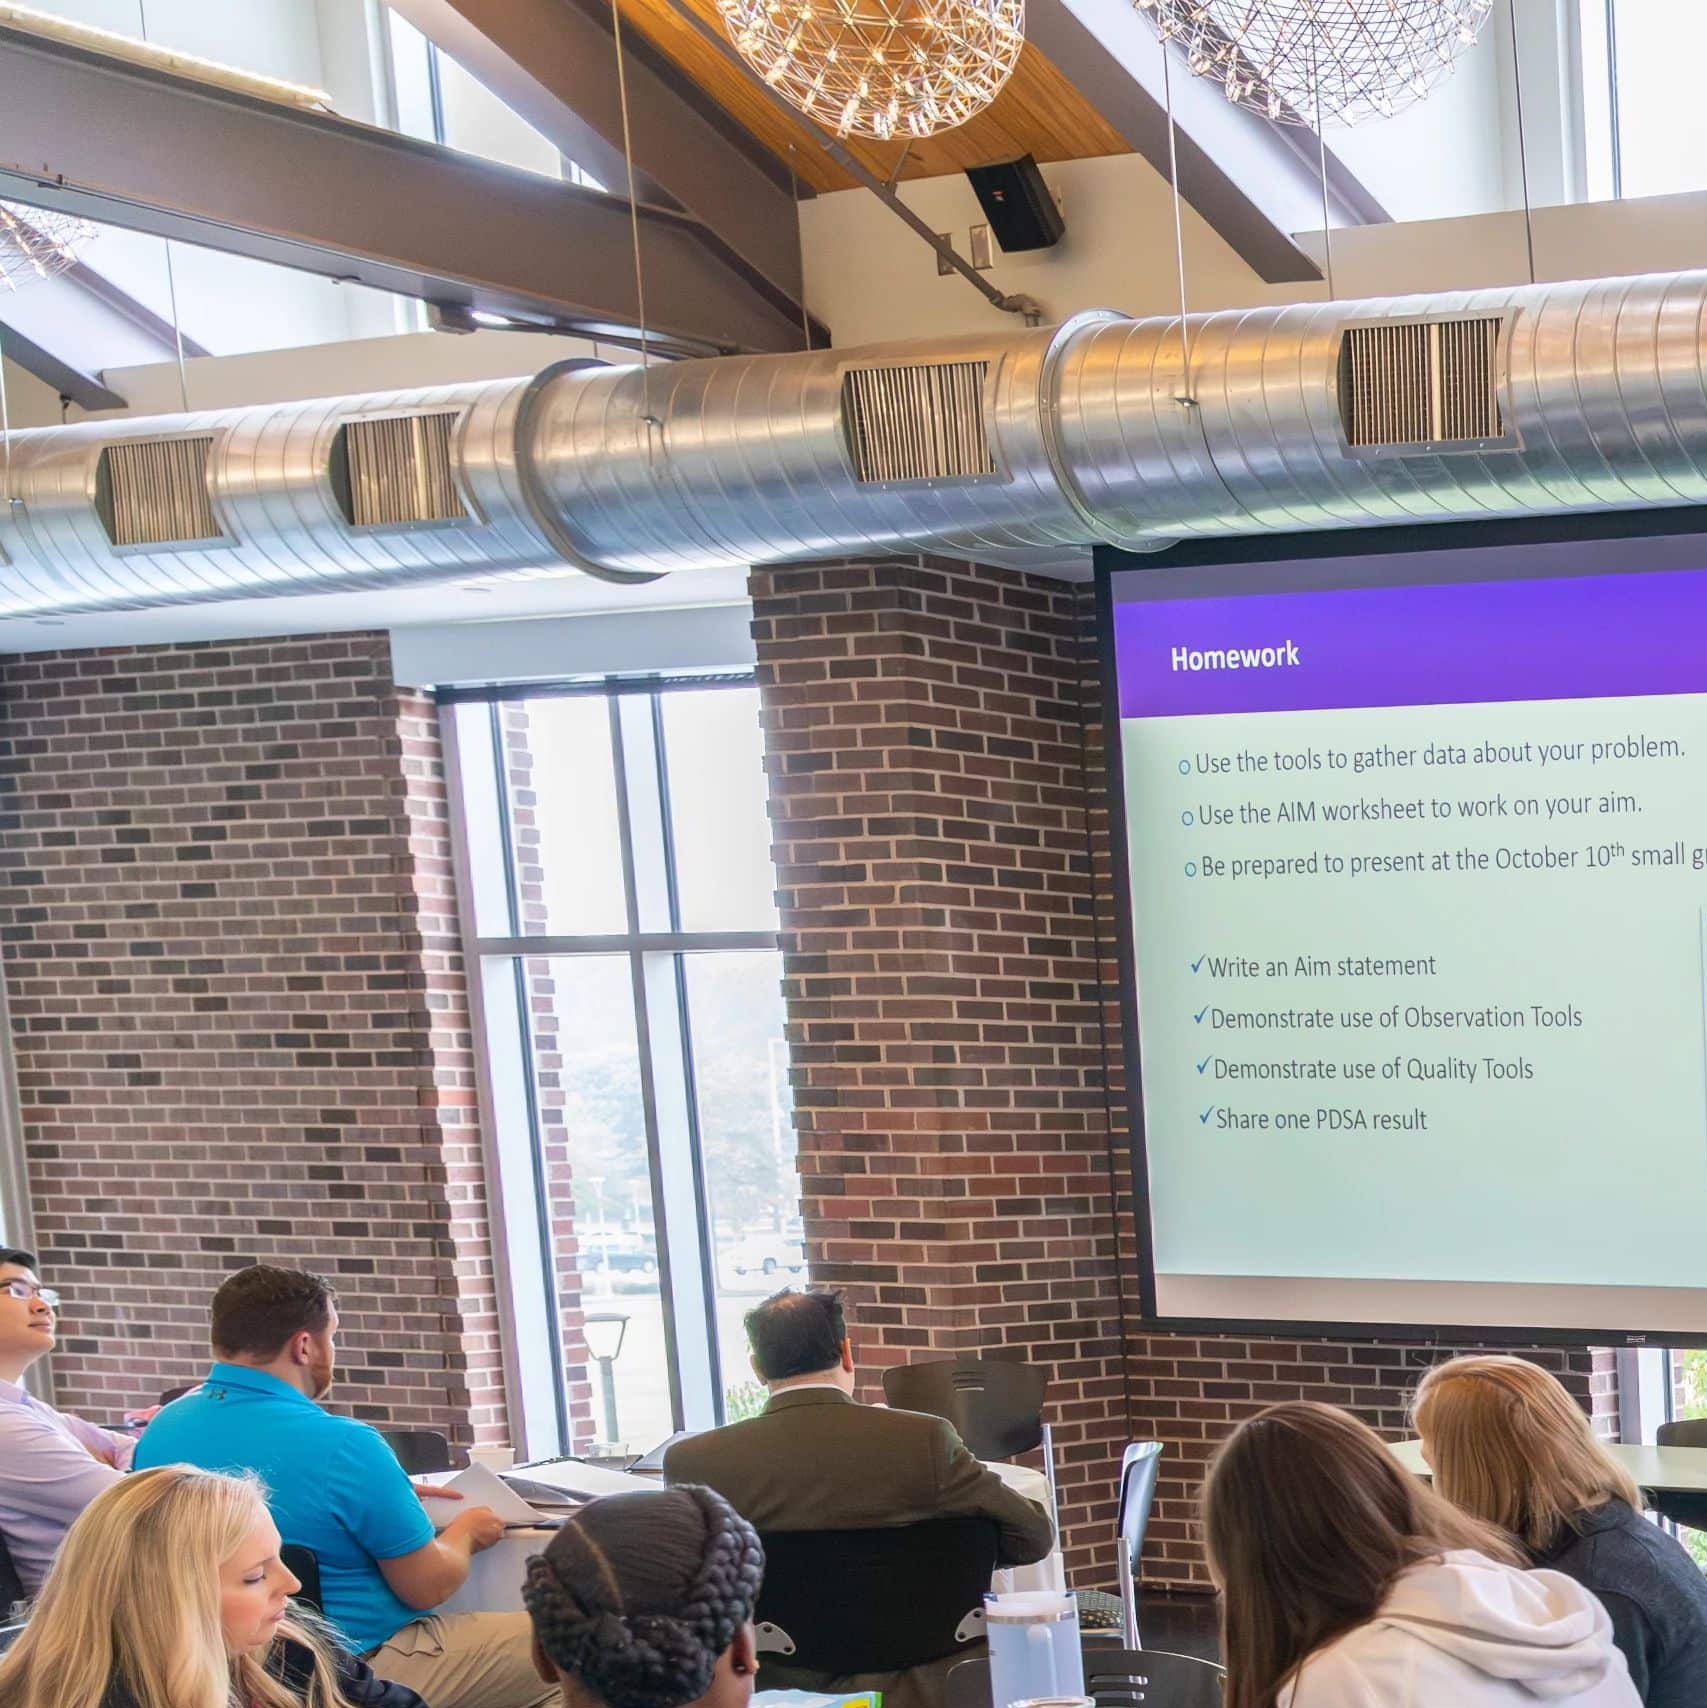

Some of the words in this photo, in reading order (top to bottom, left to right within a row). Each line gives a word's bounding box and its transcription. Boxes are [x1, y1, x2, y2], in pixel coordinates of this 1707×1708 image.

[1171, 639, 1300, 671] Homework
[1196, 753, 1231, 774] Use
[1236, 749, 1268, 773] the
[1273, 747, 1322, 771] tools
[1327, 749, 1348, 769] to
[1353, 743, 1417, 774] gather
[1423, 742, 1466, 766] data
[1473, 740, 1533, 764] about
[1537, 743, 1585, 767] your
[1591, 734, 1685, 765] problem.
[1199, 804, 1234, 825] Use
[1239, 801, 1271, 825] the
[1277, 800, 1316, 823] AIM
[1321, 797, 1425, 822] worksheet
[1430, 798, 1452, 819] to
[1457, 793, 1508, 817] work
[1513, 799, 1539, 816] on
[1545, 797, 1593, 820] your
[1598, 795, 1642, 814] aim.
[1202, 855, 1225, 877] Be
[1231, 850, 1318, 881] prepared
[1324, 853, 1344, 873] to
[1350, 851, 1425, 878] present
[1431, 850, 1451, 871] at
[1455, 847, 1489, 871] the
[1495, 845, 1579, 870] October
[1586, 841, 1625, 868] 10th
[1631, 841, 1685, 866] small
[1207, 956, 1260, 978] Write
[1265, 961, 1288, 977] an
[1294, 955, 1331, 977] Aim
[1337, 955, 1437, 976] statement
[1211, 1008, 1334, 1029] Demonstrate
[1340, 1012, 1374, 1028] use
[1379, 1004, 1400, 1028] of
[1404, 1005, 1525, 1028] Observation
[1529, 1003, 1583, 1027] Tools
[1214, 1058, 1337, 1080] Demonstrate
[1343, 1063, 1376, 1080] use
[1381, 1056, 1402, 1079] of
[1407, 1056, 1478, 1084] Quality
[1482, 1056, 1534, 1080] Tools
[1216, 1106, 1270, 1129] Share
[1274, 1113, 1311, 1130] one
[1316, 1108, 1368, 1130] PDSA
[1373, 1107, 1428, 1130] result
